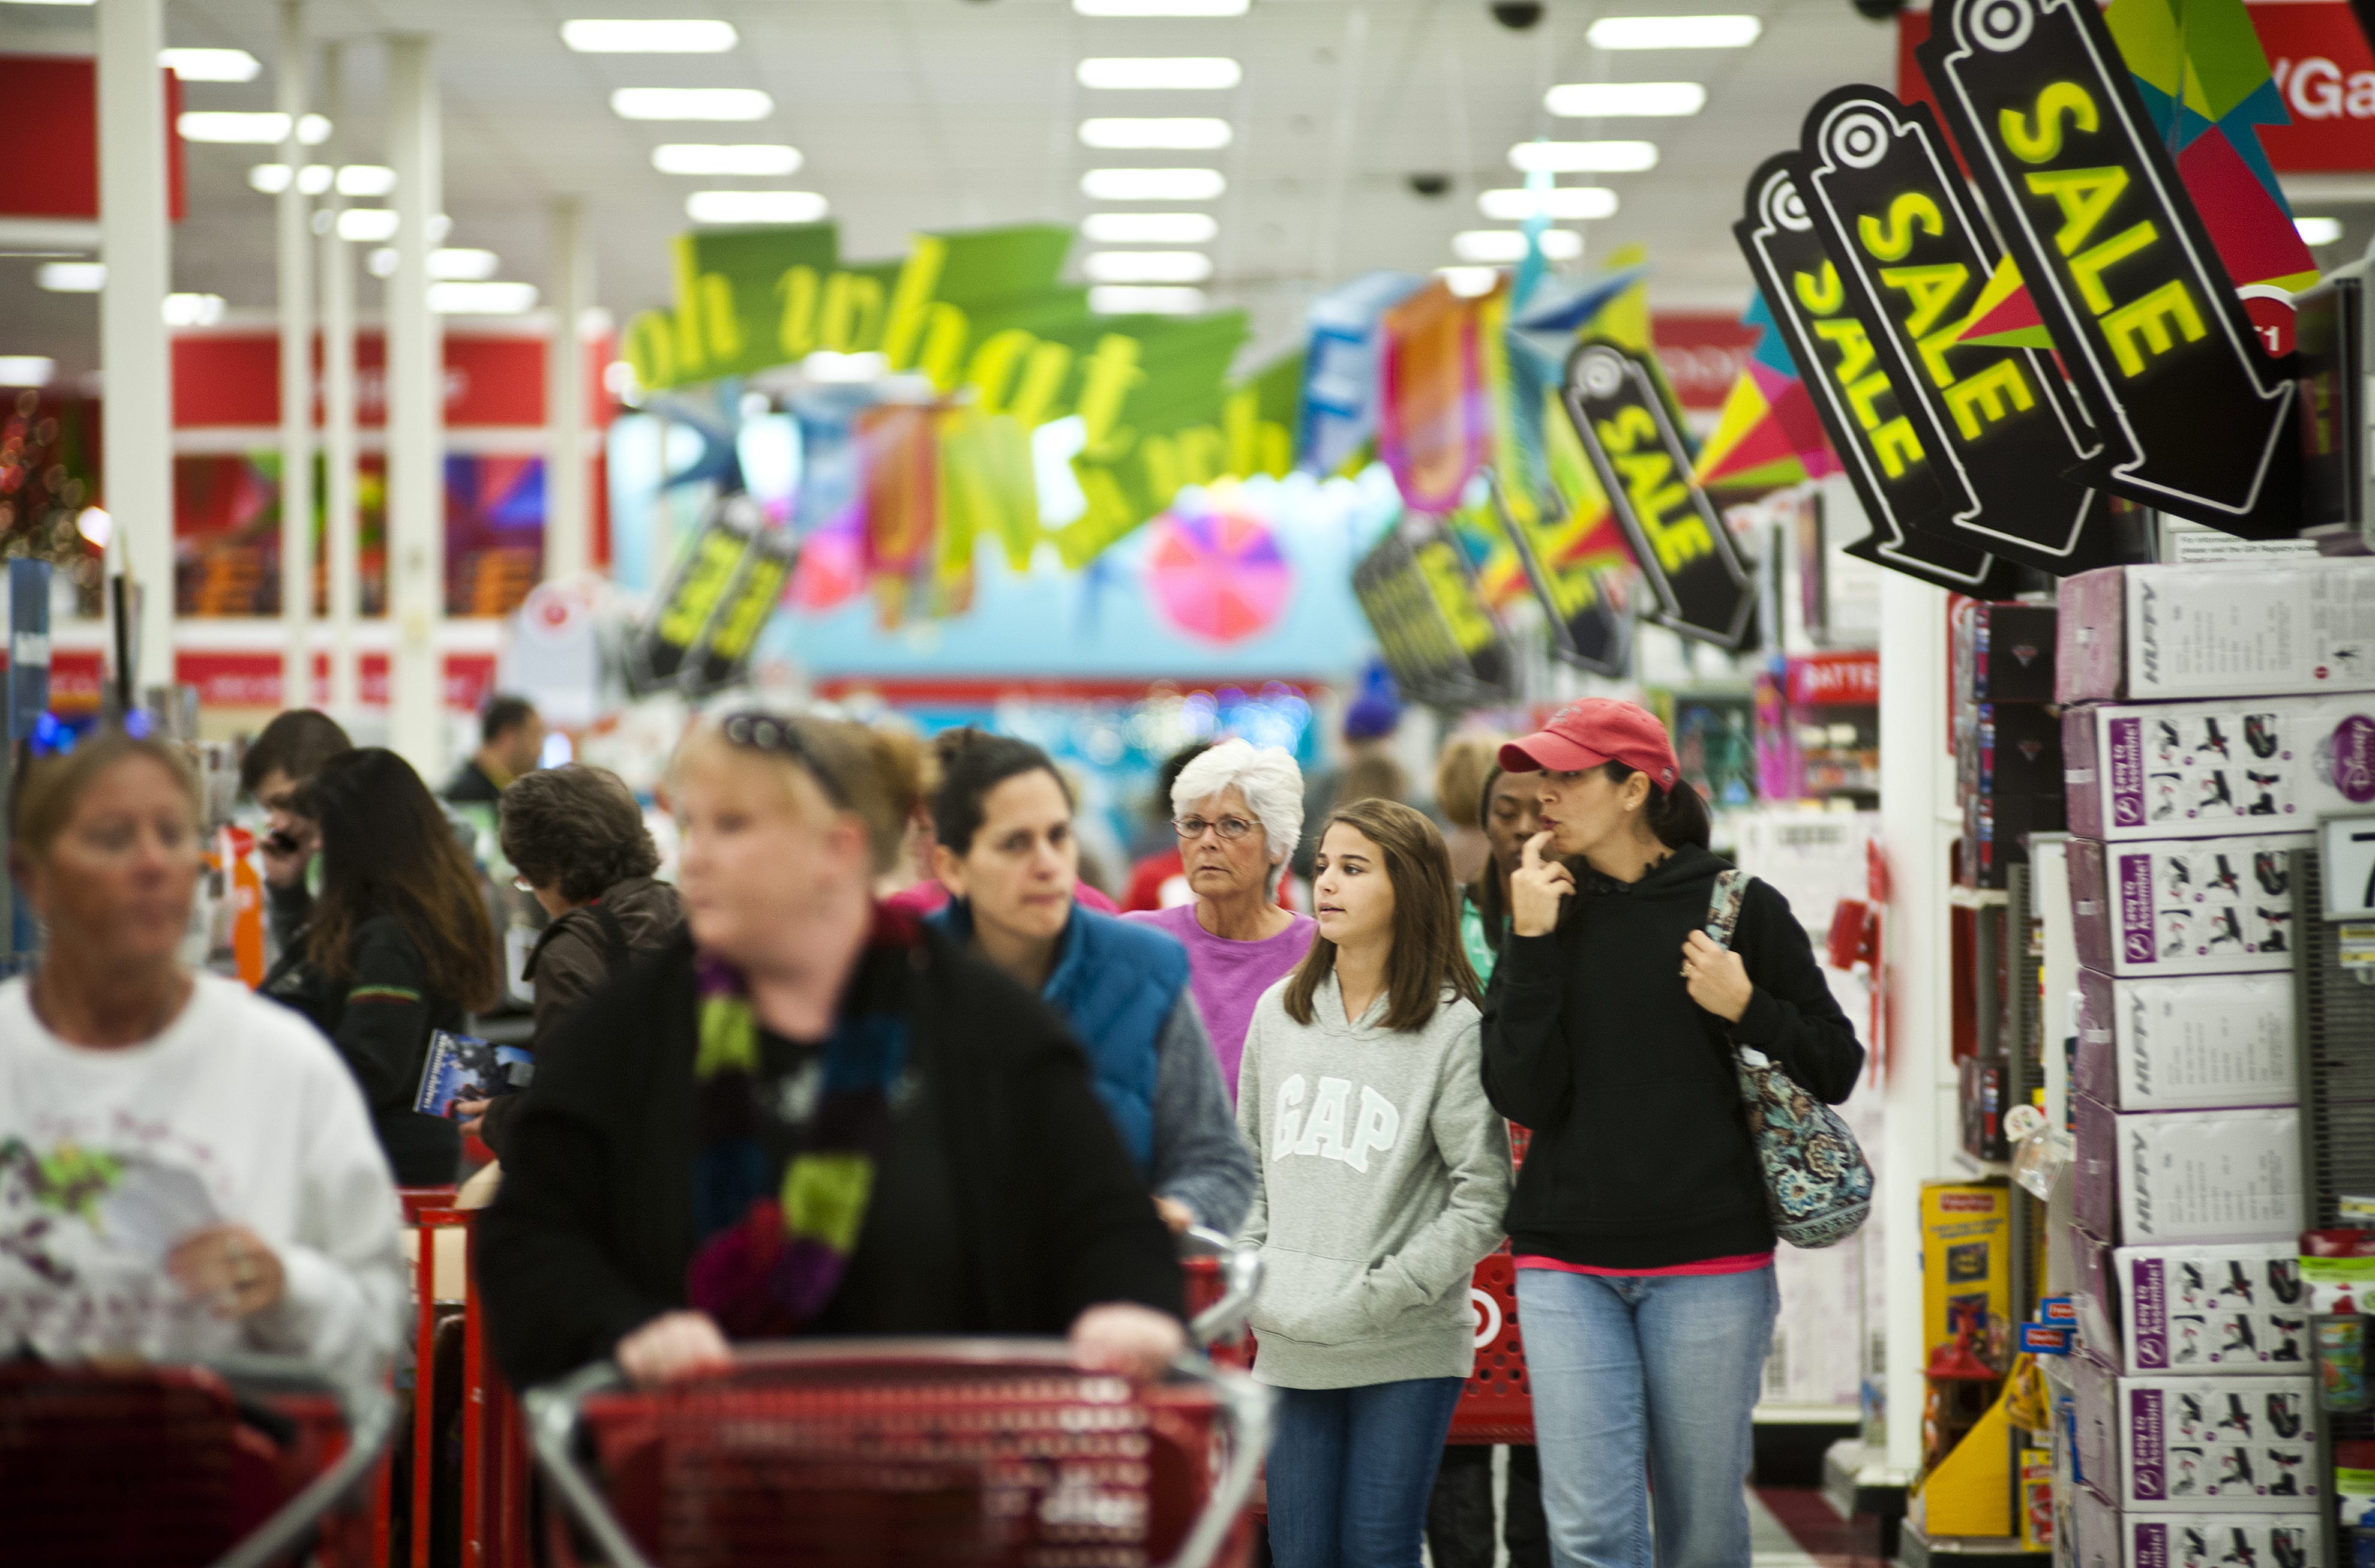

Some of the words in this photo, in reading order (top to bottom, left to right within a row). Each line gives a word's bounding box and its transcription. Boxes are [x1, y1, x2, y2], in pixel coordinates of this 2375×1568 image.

[1999, 81, 2208, 379] SALE
[1858, 192, 2035, 441] SALE
[1597, 404, 1713, 574] SALE
[2140, 580, 2160, 684] HUFFY
[2131, 992, 2152, 1096] HUFFY
[1271, 1073, 1400, 1173] GAP
[2131, 1129, 2154, 1234] HUFFY
